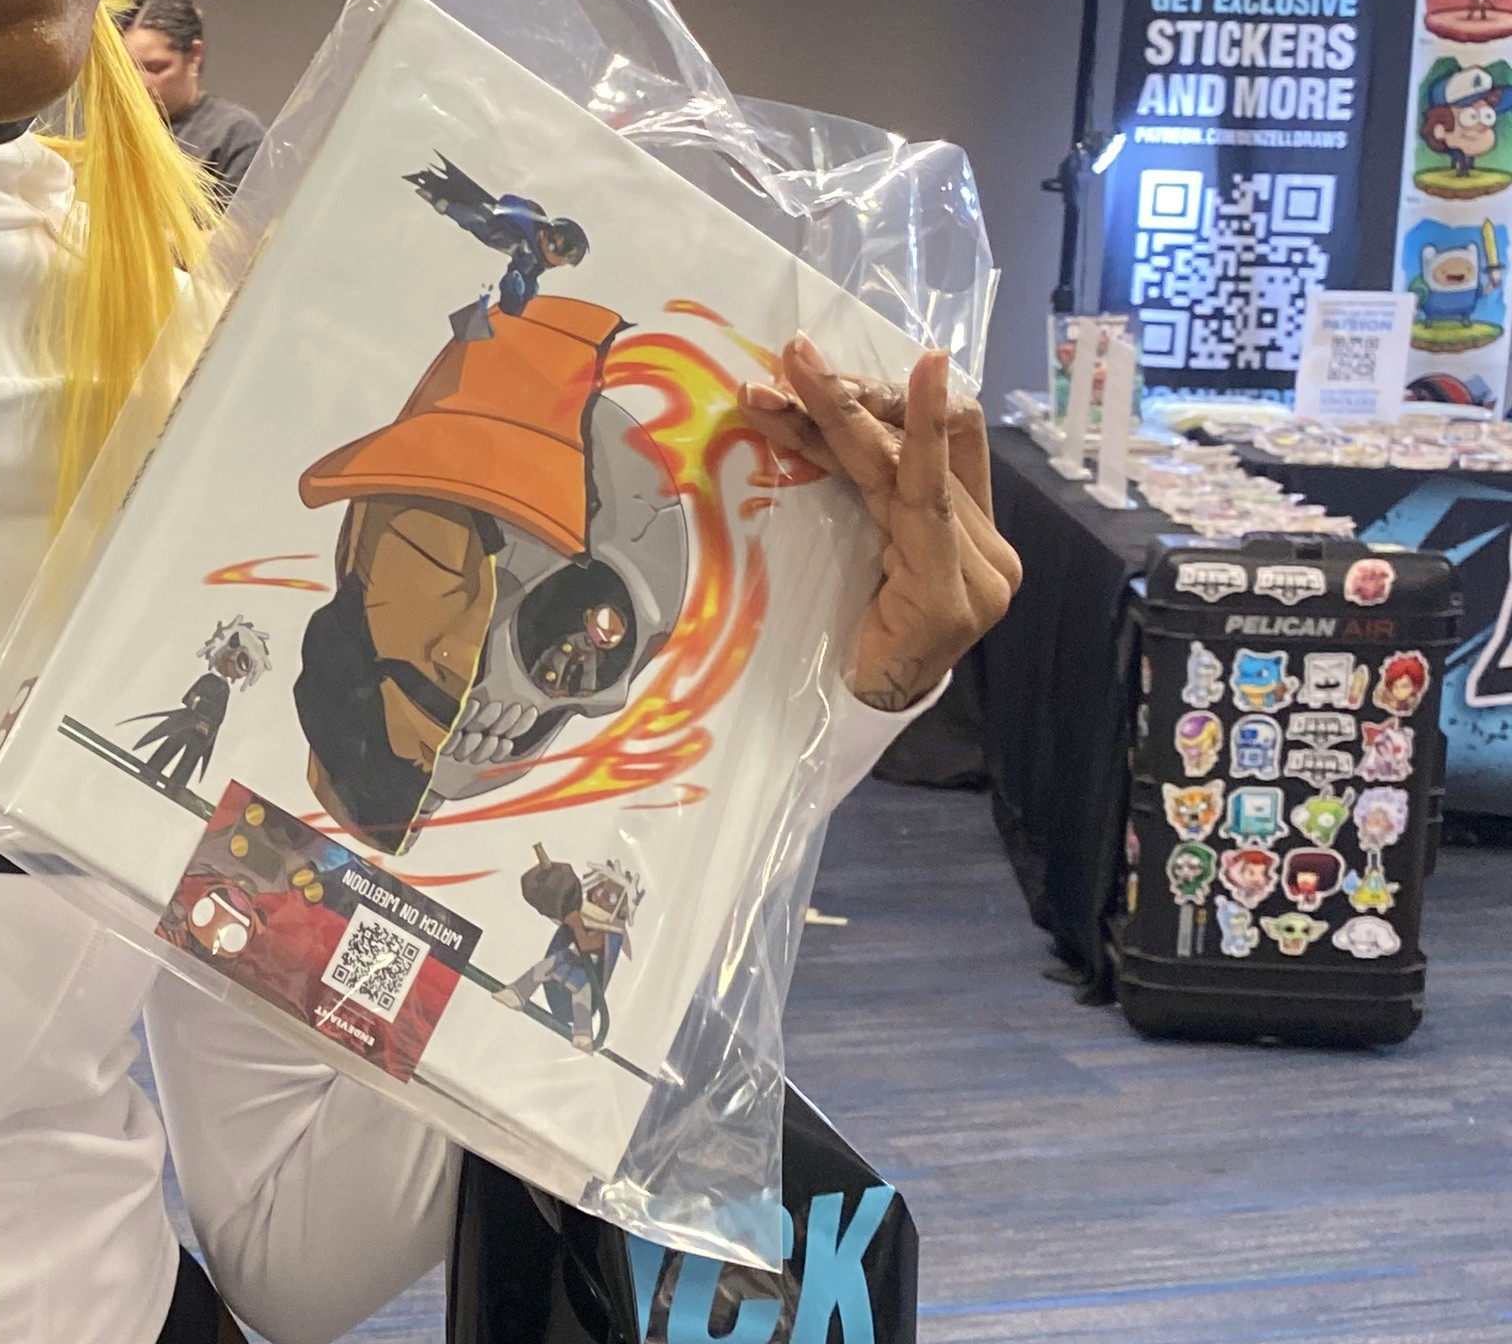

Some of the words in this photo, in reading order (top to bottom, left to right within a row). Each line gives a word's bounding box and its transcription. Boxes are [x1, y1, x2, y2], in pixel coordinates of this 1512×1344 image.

[1144, 18, 1358, 70] STICKERS
[1136, 72, 1227, 117] AND
[1232, 75, 1355, 121] MORE
[1224, 614, 1337, 637] PELICAN
[1343, 617, 1395, 637] AIR
[341, 868, 401, 914] WEBTOON
[398, 902, 420, 926] ON
[419, 913, 464, 951] WATCH
